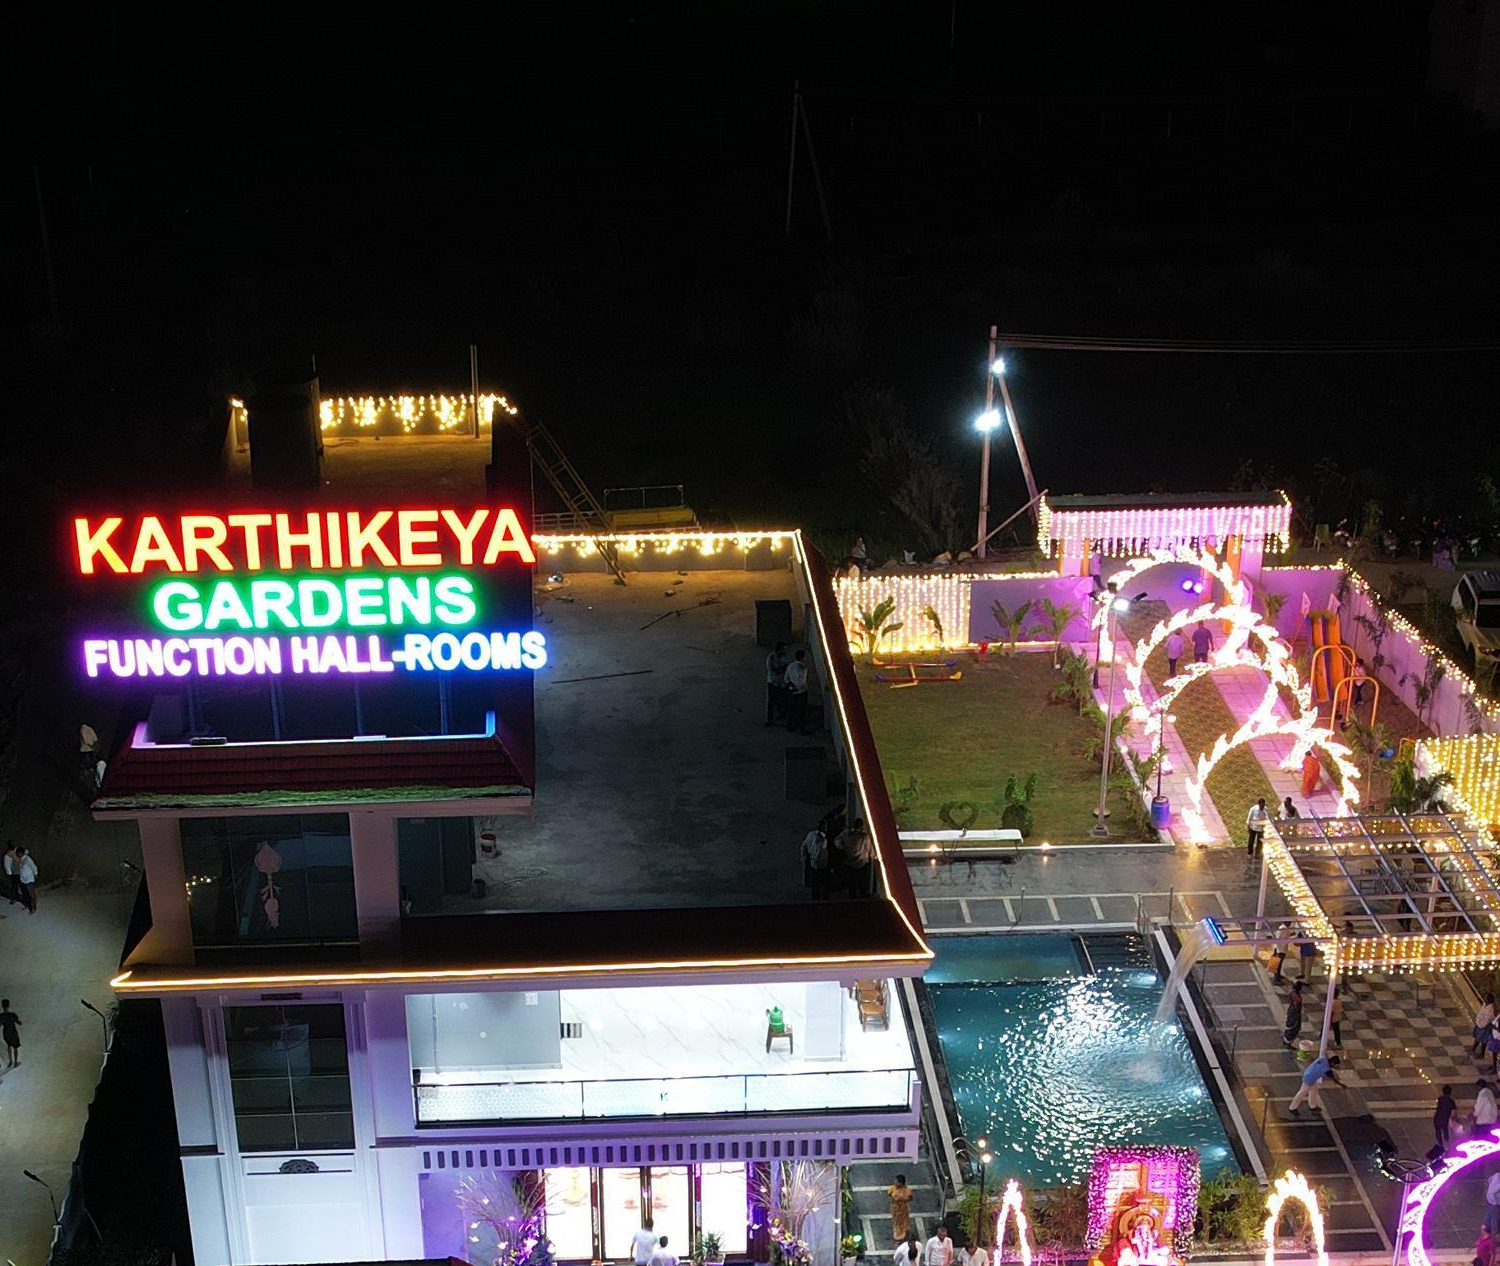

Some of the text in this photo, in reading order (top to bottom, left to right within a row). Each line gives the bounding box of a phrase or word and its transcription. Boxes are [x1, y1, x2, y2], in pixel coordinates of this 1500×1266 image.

[74, 508, 536, 574] KARTHIKEYA
[152, 577, 478, 632] GARDENS
[83, 637, 281, 677] FUNCTION
